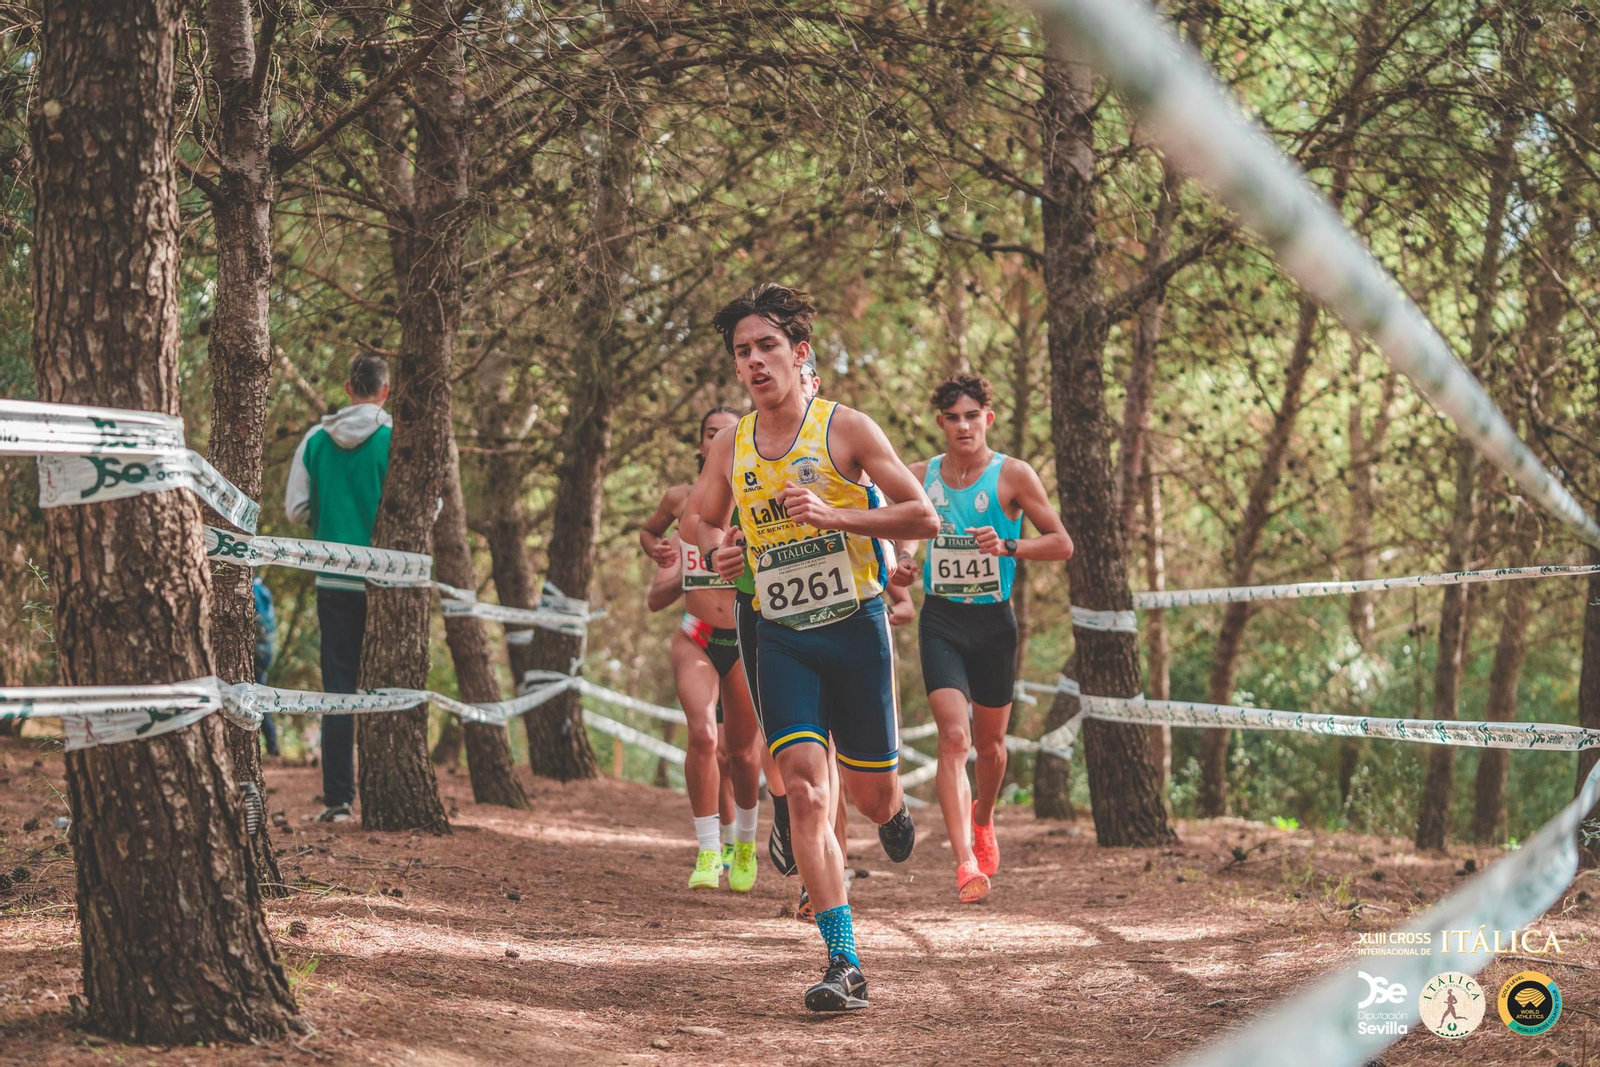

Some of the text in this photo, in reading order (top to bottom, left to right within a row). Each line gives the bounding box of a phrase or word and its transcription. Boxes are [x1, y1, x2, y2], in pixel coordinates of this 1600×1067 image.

[750, 498, 792, 525] LaM
[777, 543, 821, 560] ITÁLICA
[938, 557, 995, 579] 6141
[767, 566, 849, 611] 8261
